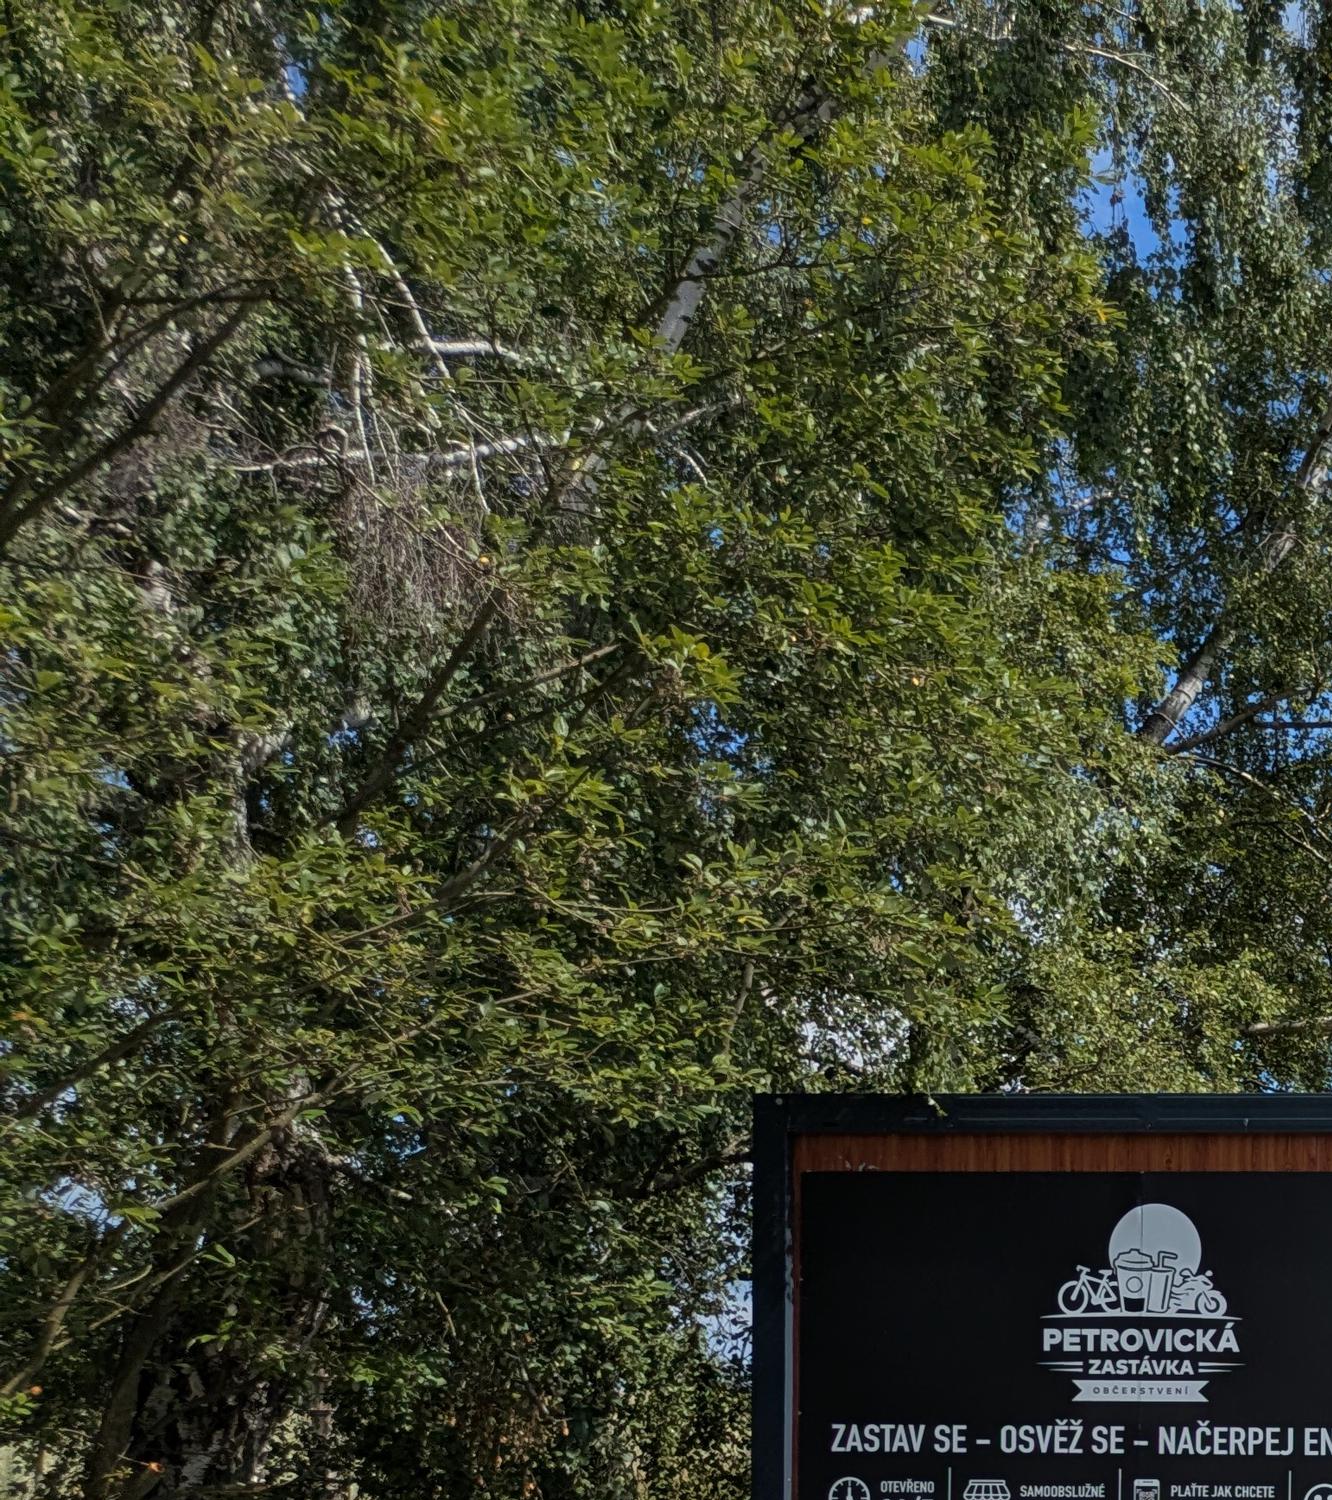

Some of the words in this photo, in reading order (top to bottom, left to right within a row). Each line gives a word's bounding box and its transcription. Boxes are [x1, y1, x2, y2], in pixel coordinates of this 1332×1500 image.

[1043, 1322, 1240, 1352] PETROVICKÁ
[1089, 1355, 1194, 1375] ZASTÁVKA
[1092, 1384, 1189, 1396] OBČERSTVENÍ
[831, 1424, 925, 1452] ZASTAV
[934, 1425, 967, 1453] SE
[1001, 1419, 1083, 1453] OSVĚŽ
[1092, 1426, 1125, 1454] SE
[1159, 1420, 1293, 1455] NAČERPEJ
[881, 1479, 934, 1493] OTEVŘENO
[1020, 1483, 1105, 1497] SAMOOBSLUŽNÉ
[1171, 1483, 1209, 1497] PLAŤTE
[1211, 1485, 1232, 1497] JAK
[1235, 1486, 1275, 1498] CHCETE
